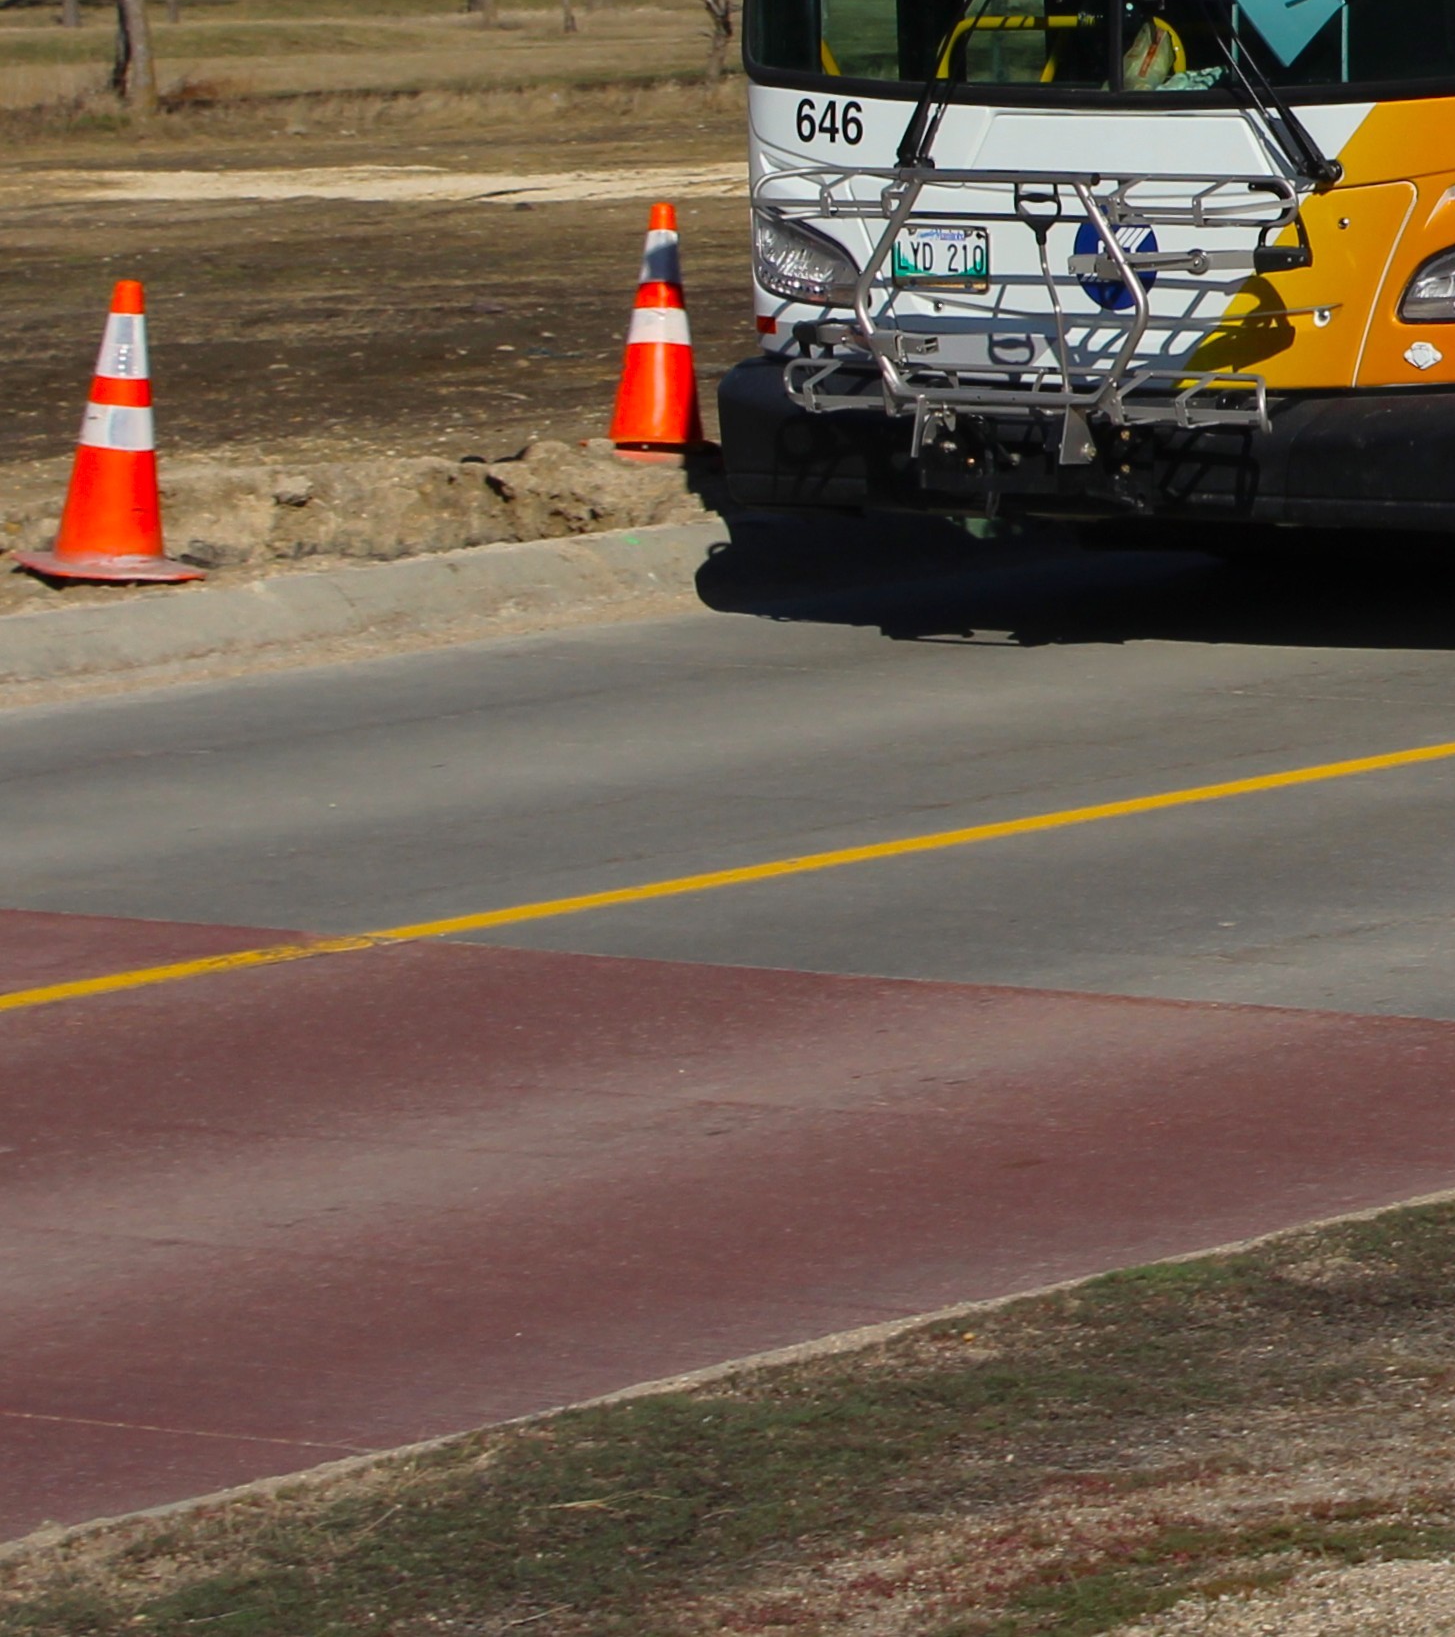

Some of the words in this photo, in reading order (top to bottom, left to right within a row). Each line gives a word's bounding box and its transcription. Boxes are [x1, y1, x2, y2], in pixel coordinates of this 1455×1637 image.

[796, 98, 863, 145] 646
[897, 241, 934, 271] LYD
[947, 243, 985, 274] 210
